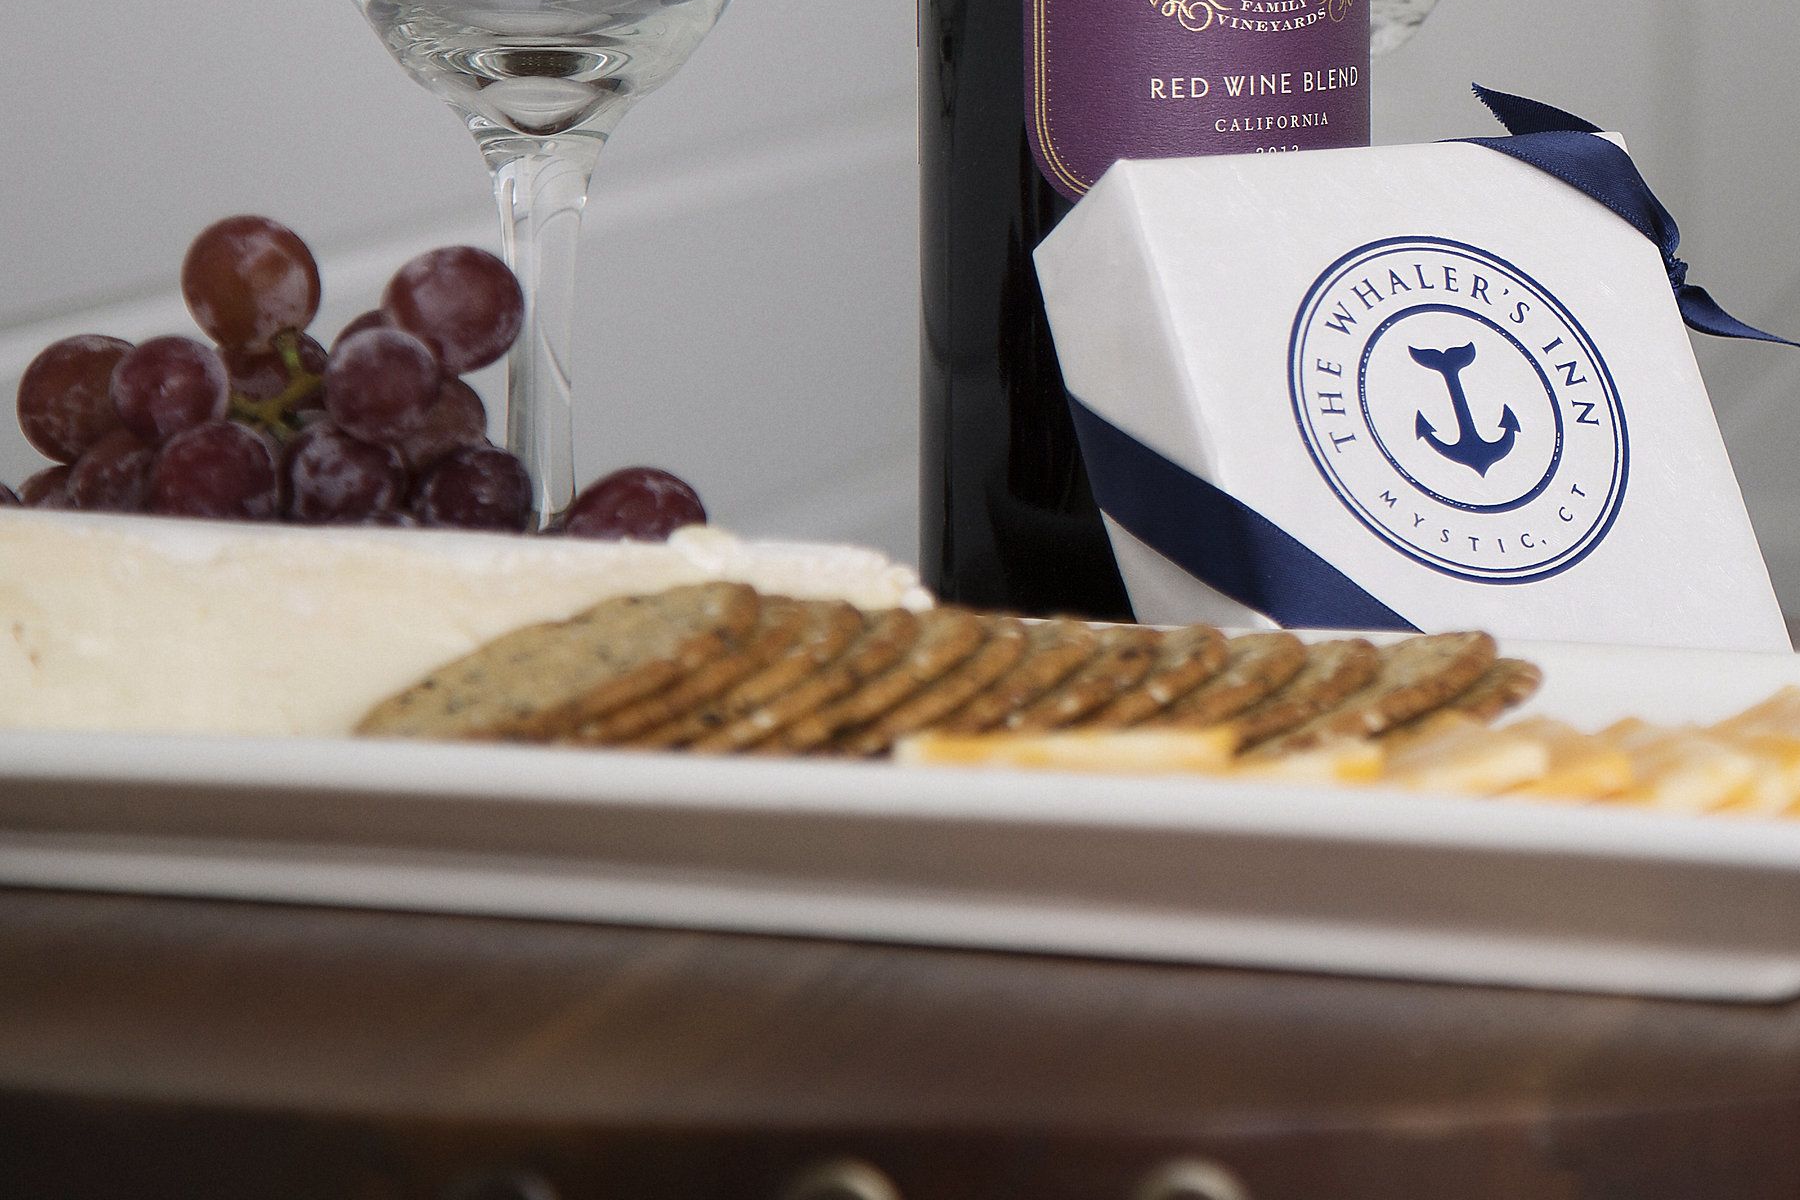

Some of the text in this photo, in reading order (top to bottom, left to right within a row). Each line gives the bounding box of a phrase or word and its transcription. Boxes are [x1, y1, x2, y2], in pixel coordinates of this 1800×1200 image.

[1216, 8, 1326, 32] VINEYARDS
[1151, 66, 1359, 99] RED WINE BLEND
[1215, 112, 1329, 132] CALIFORNIA
[1316, 264, 1600, 453] THE WHALER'S INN
[1558, 483, 1586, 522] CT
